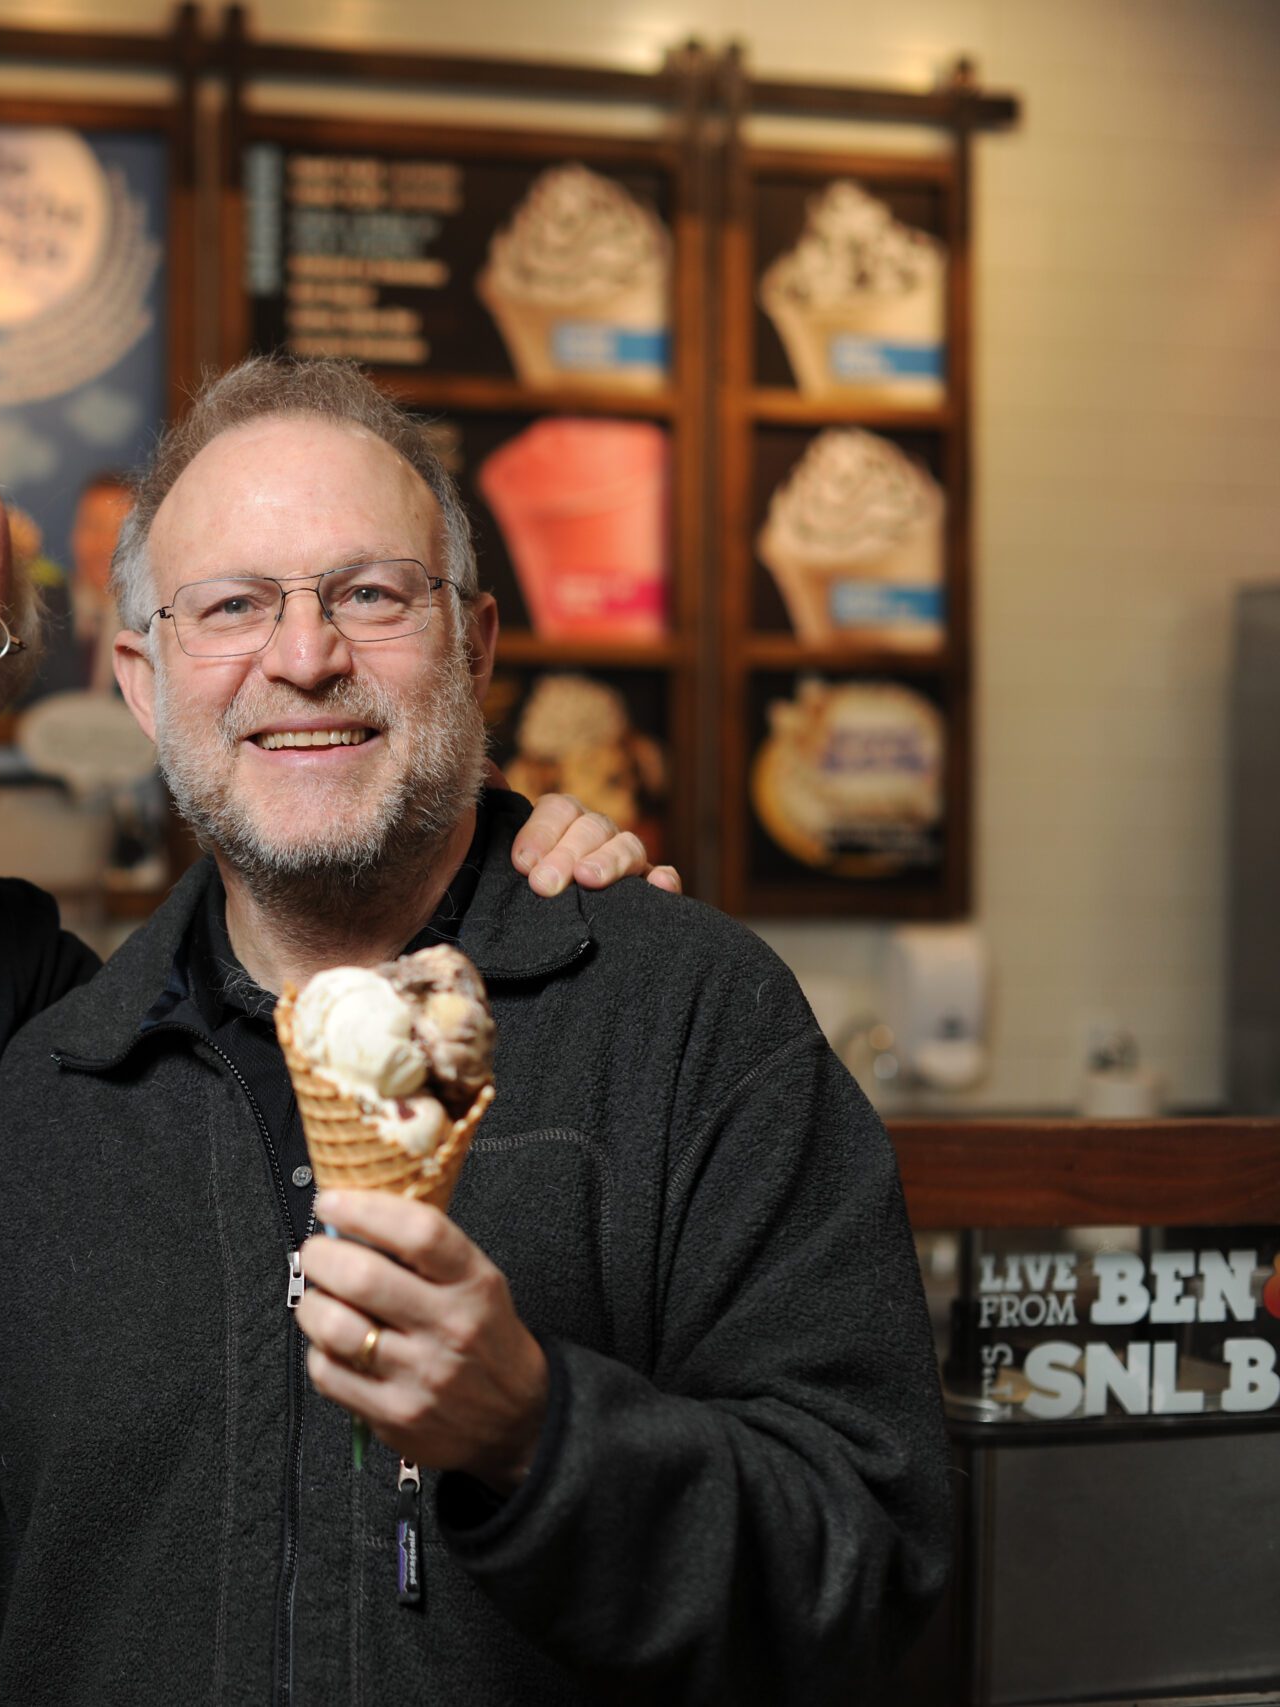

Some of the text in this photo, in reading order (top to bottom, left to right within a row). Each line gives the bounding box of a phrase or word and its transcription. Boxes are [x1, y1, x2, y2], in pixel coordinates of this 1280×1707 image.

[979, 1252, 1077, 1292] LIVE
[1090, 1250, 1258, 1325] BEN
[978, 1293, 1078, 1328] FROM
[1022, 1340, 1205, 1420] SNL
